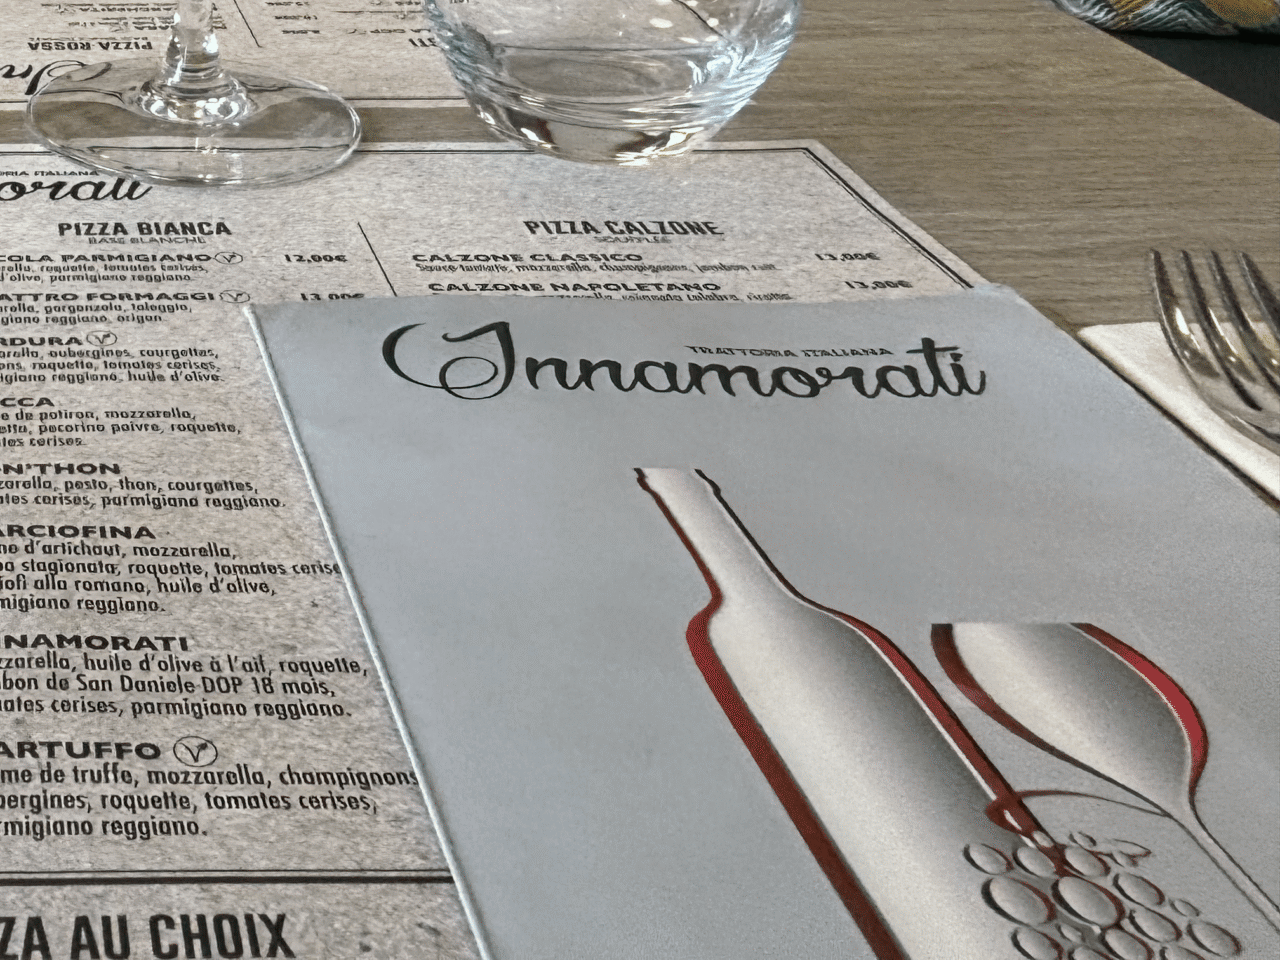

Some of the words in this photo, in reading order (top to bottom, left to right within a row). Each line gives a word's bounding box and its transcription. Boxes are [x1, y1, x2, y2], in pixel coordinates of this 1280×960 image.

[28, 41, 90, 50] ROSSA
[96, 41, 152, 50] PIZZA
[58, 222, 128, 236] PIZZA
[138, 222, 232, 236] BIANCA
[523, 221, 601, 235] PIZZA
[605, 221, 723, 235] CALZONE
[61, 254, 213, 262] PARMIGIANO
[284, 254, 348, 262] 12,00€
[412, 254, 522, 262] CALZONE
[529, 253, 643, 262] CLASSICO
[550, 283, 721, 292] NAPOLETANO
[86, 292, 214, 301] FORMAGGI
[382, 321, 987, 400] Innamorati
[84, 653, 131, 671] huile
[139, 654, 202, 672] d'olive
[210, 655, 220, 672] à
[279, 657, 369, 677] roquette,
[46, 675, 69, 691] de
[79, 676, 113, 692] San
[120, 676, 196, 694] Daniele
[202, 677, 243, 694] DOP
[252, 677, 273, 694] 18
[282, 677, 335, 697] mois,
[51, 697, 123, 717] cerises,
[131, 698, 247, 719] parmigiano
[255, 698, 352, 721] reggiano.
[40, 762, 66, 784] de
[73, 764, 138, 787] truffe,
[147, 765, 272, 788] mozzarella,
[101, 792, 198, 815] roquette,
[205, 791, 291, 811] tomates
[299, 792, 378, 815] cerises,
[101, 818, 208, 841] reggiano.
[71, 914, 131, 960] AU
[148, 911, 296, 959] CHOIX
